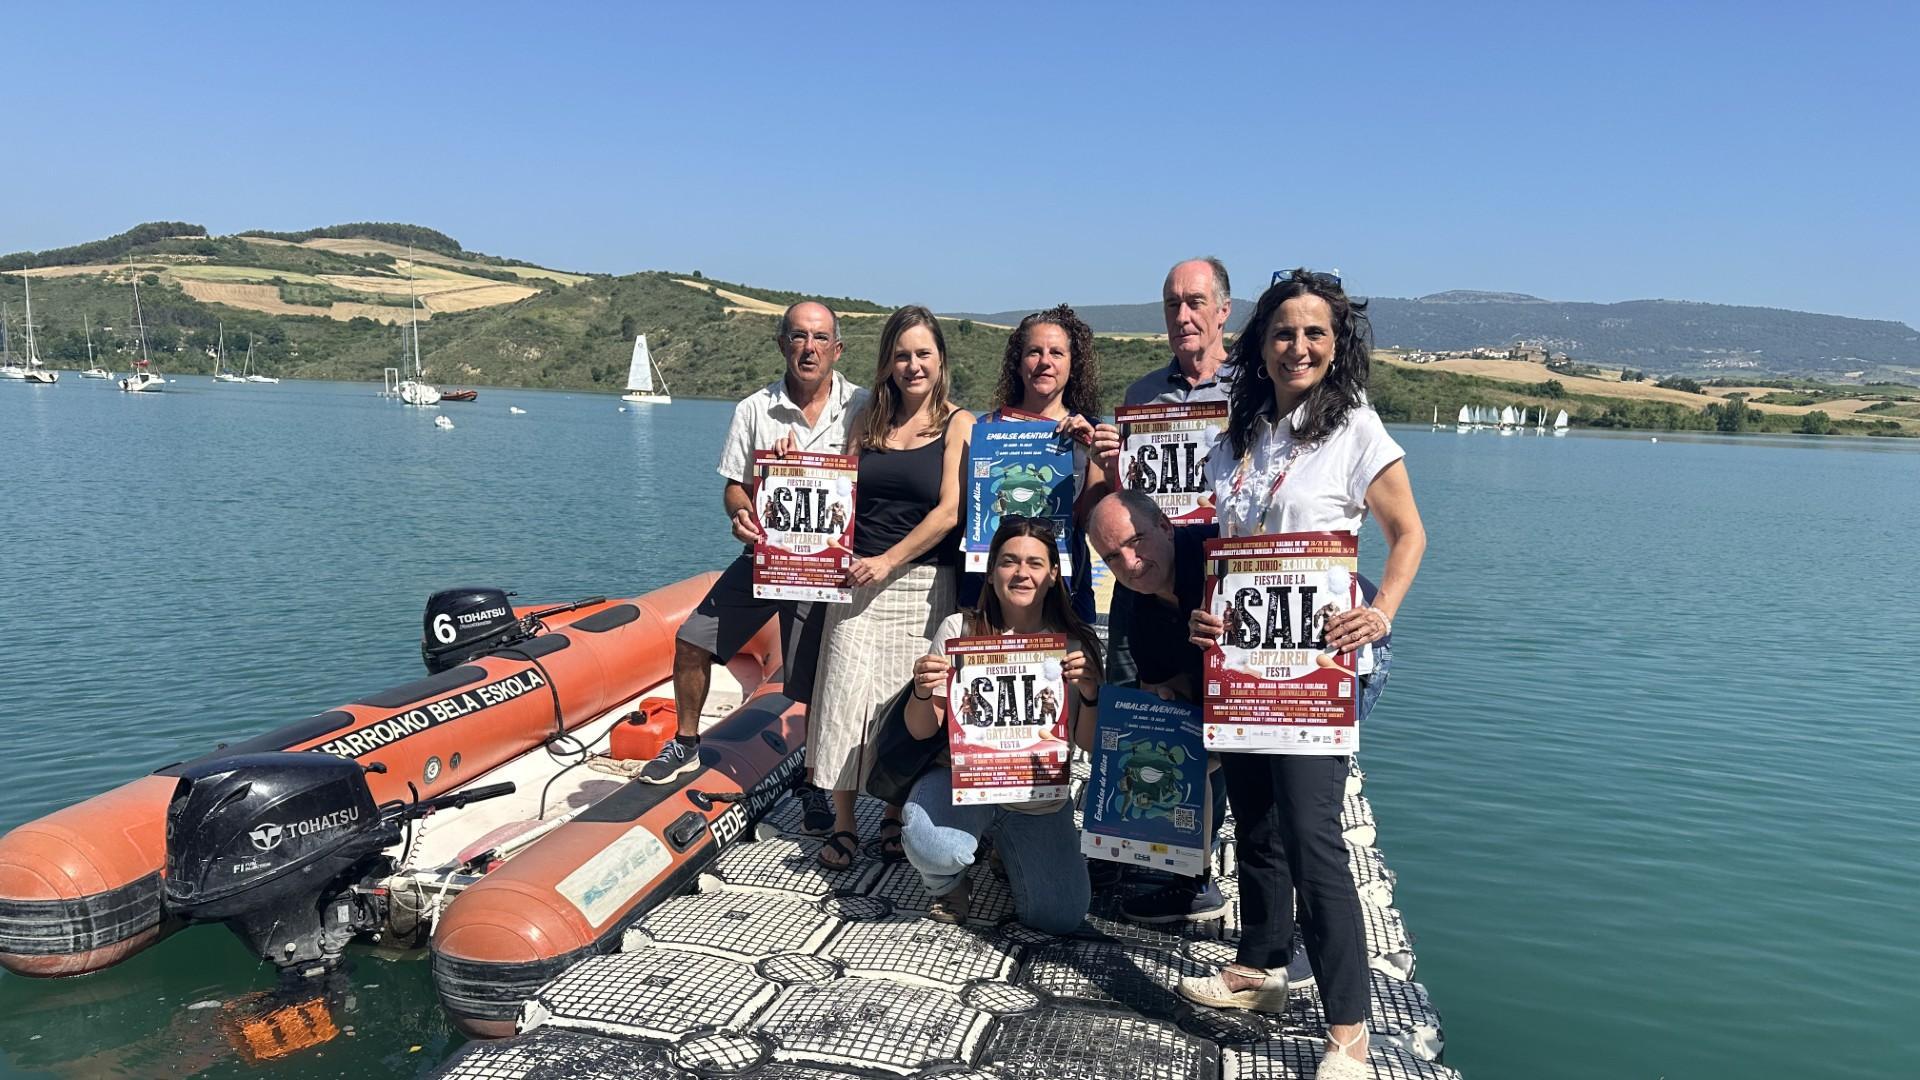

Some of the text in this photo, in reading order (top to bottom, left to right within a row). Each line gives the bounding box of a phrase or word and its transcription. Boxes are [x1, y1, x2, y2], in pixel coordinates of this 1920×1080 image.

[1152, 422, 1168, 432] JUNIO
[986, 432, 1018, 440] EMBALSE
[1152, 433, 1189, 444] FIESTA DE LA
[1137, 442, 1205, 494] SAL
[773, 486, 834, 533] SAL
[973, 502, 980, 512] de
[972, 512, 980, 541] Embalse
[784, 534, 822, 545] GATZAREN
[1233, 561, 1241, 572] 28
[1244, 561, 1252, 571] DE
[1255, 560, 1278, 571] JUNIO
[1282, 558, 1318, 570] EKAINAK
[1254, 574, 1305, 585] FIESTA DE LA
[457, 606, 506, 624] TOHATSU
[1234, 586, 1327, 650] SAL
[433, 613, 456, 644] 6
[968, 656, 975, 664] 28
[977, 655, 984, 664] DE
[986, 654, 1004, 664] JUNIO
[1250, 651, 1308, 666] GATZAREN
[986, 666, 1027, 675] FIESTA DE LA
[1266, 667, 1290, 678] FESTA
[429, 694, 482, 722] BELA
[478, 670, 544, 706] ESKOLA
[971, 675, 1045, 727] SAL
[1115, 701, 1191, 716] EMBALSE AVENTURA
[986, 727, 1032, 740] GATZAREN
[1094, 754, 1108, 822] Embalse de Alloz
[286, 806, 359, 838] TOHATSU
